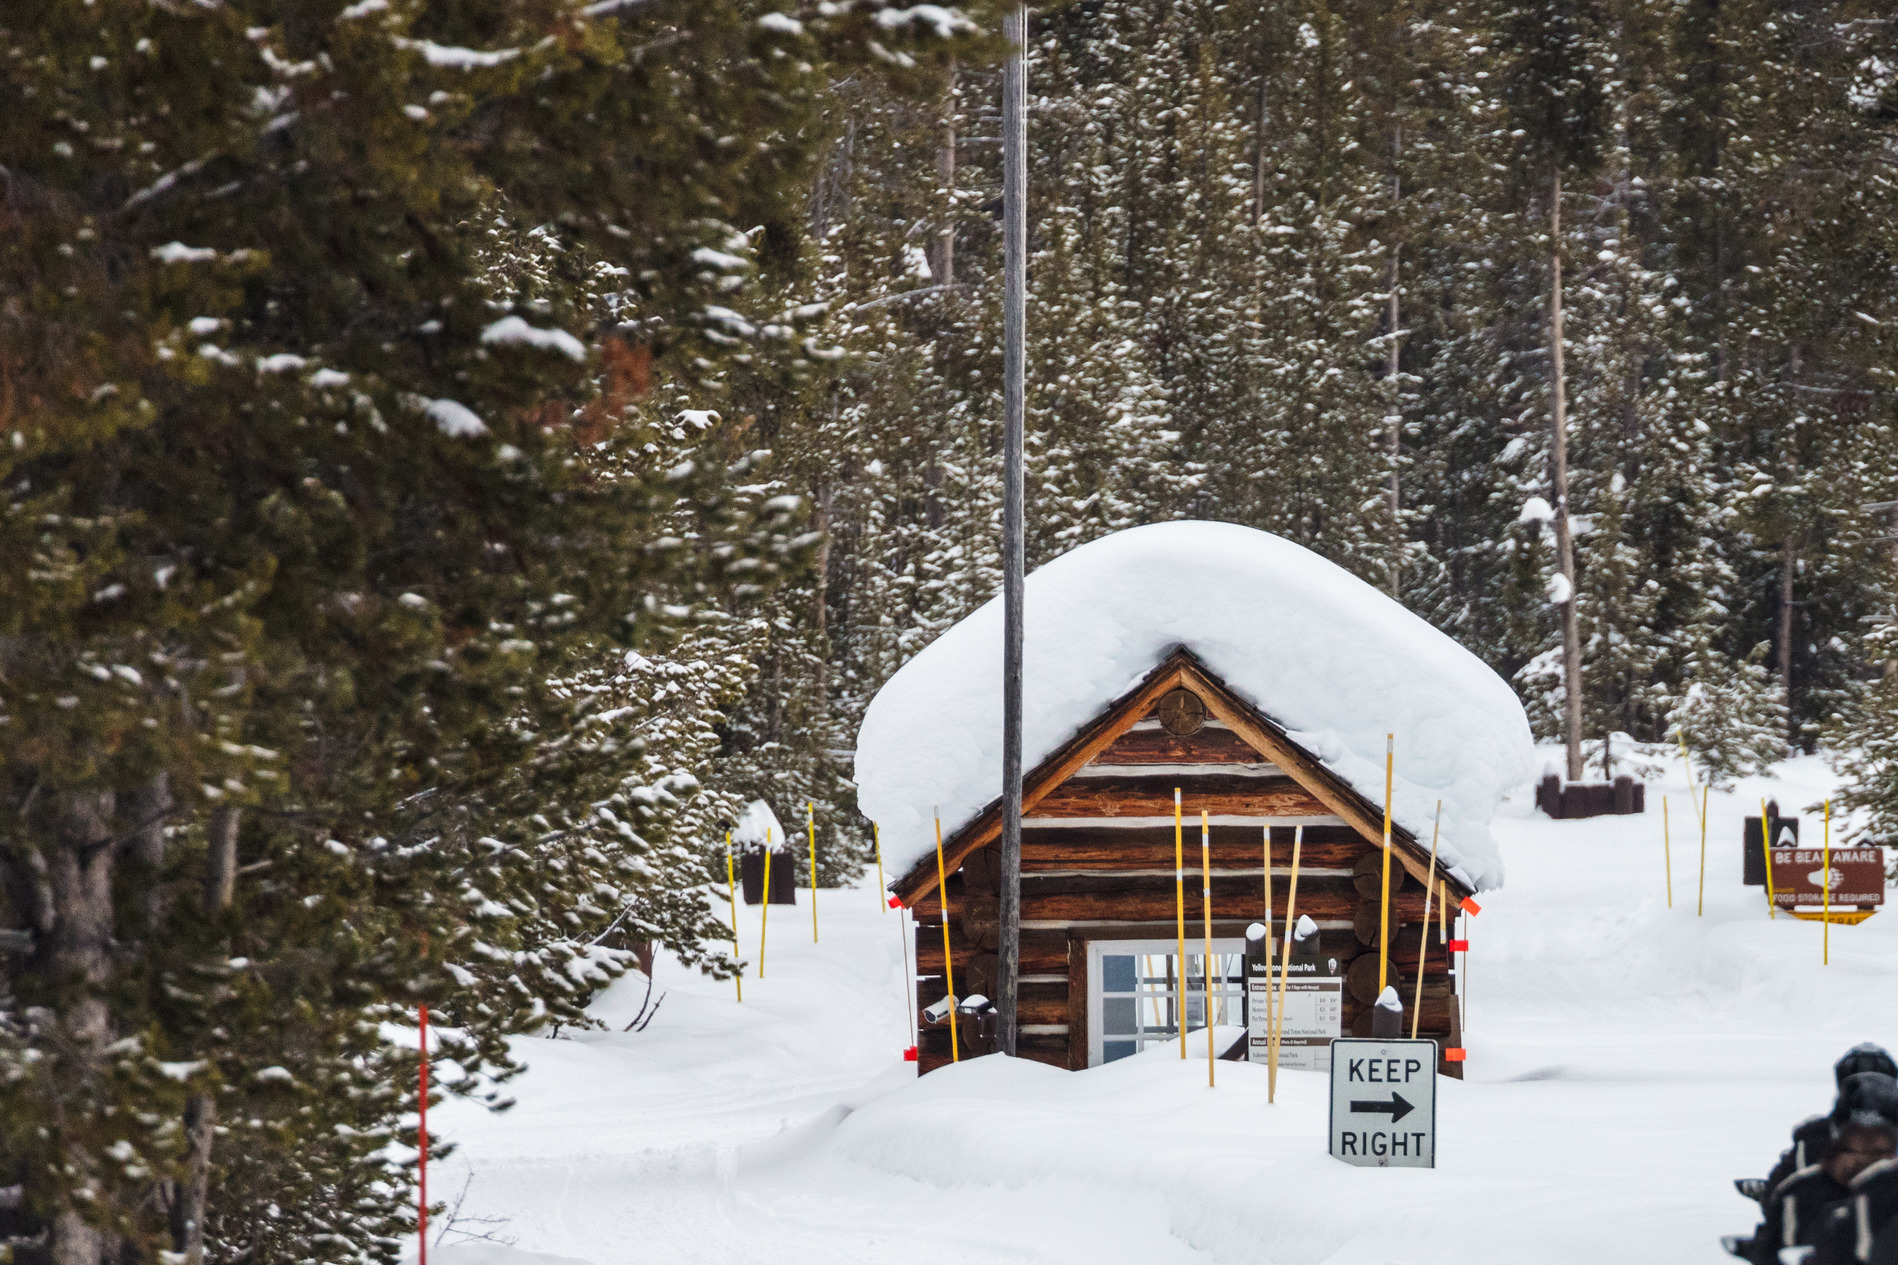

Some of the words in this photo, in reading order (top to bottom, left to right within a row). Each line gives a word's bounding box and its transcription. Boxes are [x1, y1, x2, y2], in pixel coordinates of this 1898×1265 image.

[1775, 852, 1792, 864] BE
[1832, 851, 1876, 862] AWARE
[1773, 894, 1796, 902] FOOD
[1252, 963, 1281, 971] Yelloone
[1304, 963, 1316, 971] Park
[1349, 1058, 1421, 1082] KEEP
[1341, 1131, 1425, 1156] RIGHT
